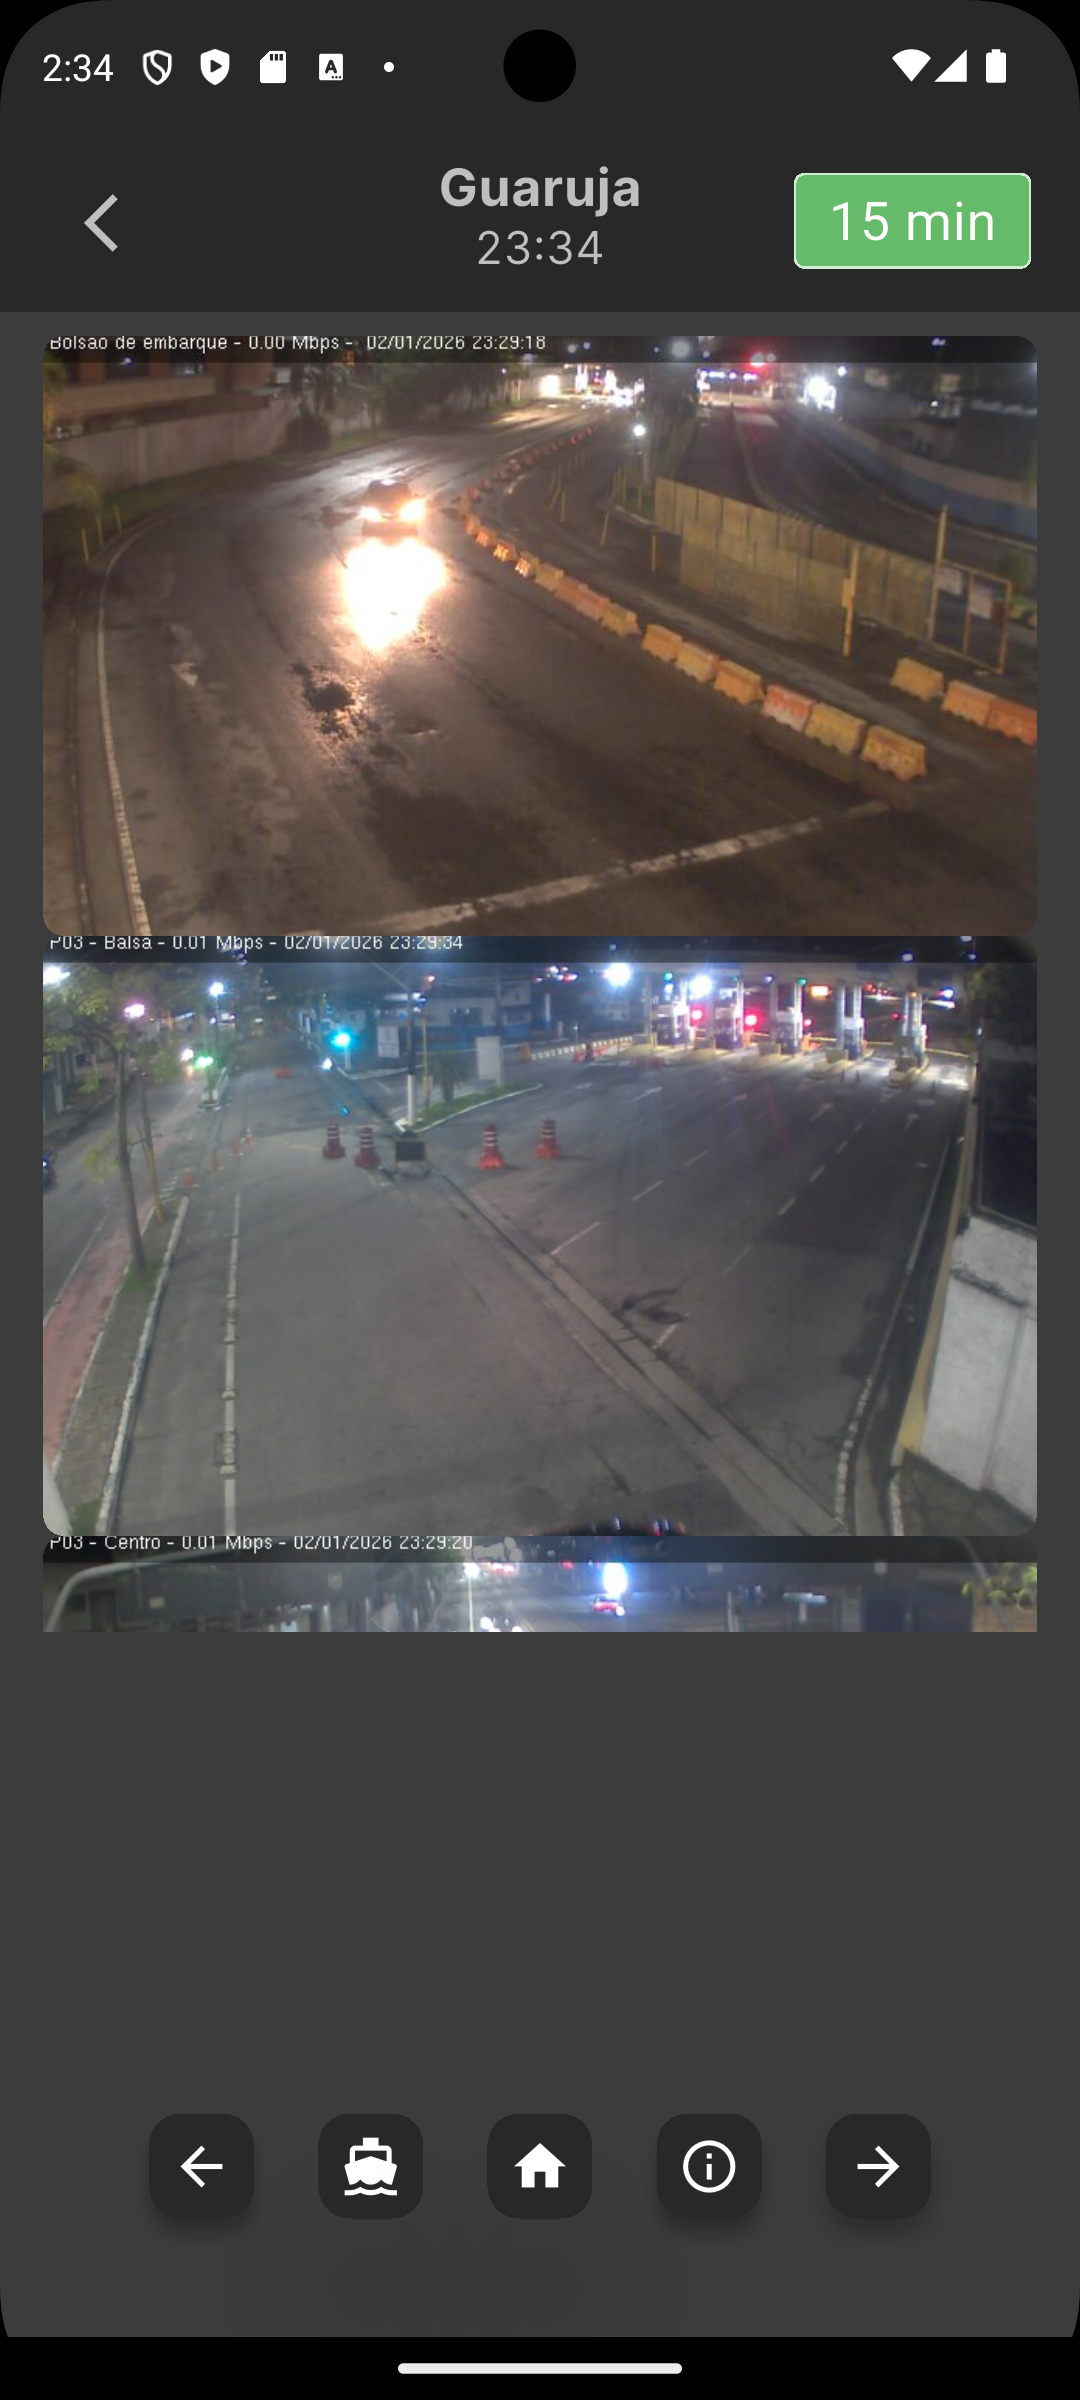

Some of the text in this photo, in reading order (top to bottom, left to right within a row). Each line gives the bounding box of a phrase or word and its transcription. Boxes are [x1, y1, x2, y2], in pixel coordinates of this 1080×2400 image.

[43, 53, 114, 83] 2:34
[440, 166, 640, 218] Guaruja
[831, 201, 995, 241] 15 min
[477, 230, 604, 265] 23:34
